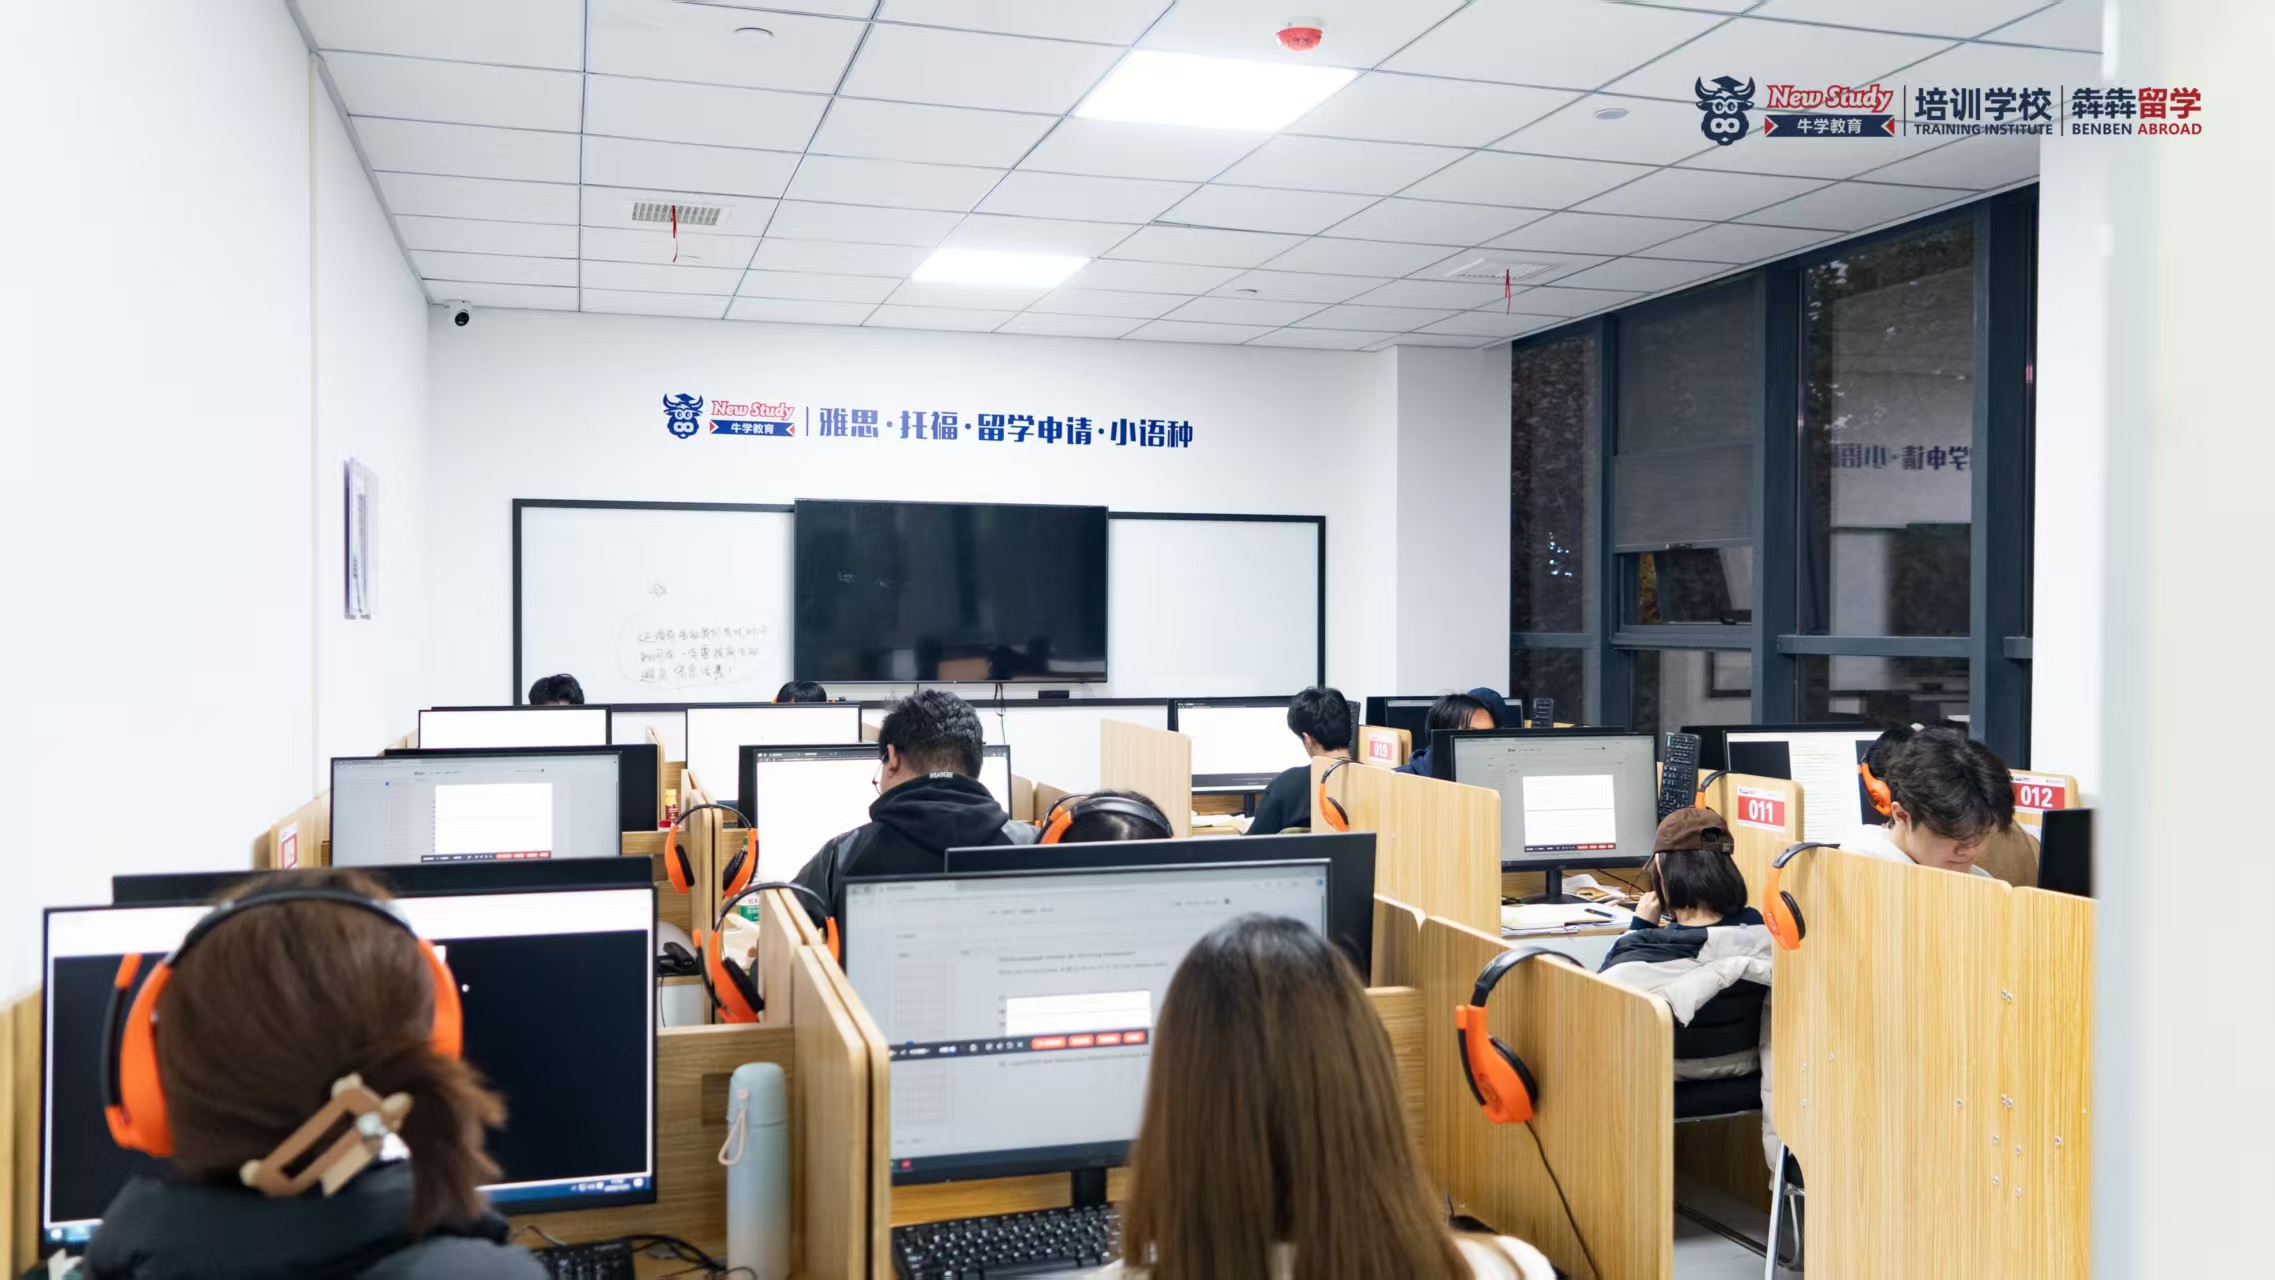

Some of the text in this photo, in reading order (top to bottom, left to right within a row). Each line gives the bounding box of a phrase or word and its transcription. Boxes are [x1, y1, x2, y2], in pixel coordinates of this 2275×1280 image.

[711, 400, 796, 419] New Study
[730, 422, 776, 435] 牛学教育
[2021, 786, 2053, 808] 012
[1749, 799, 1773, 823] 011
